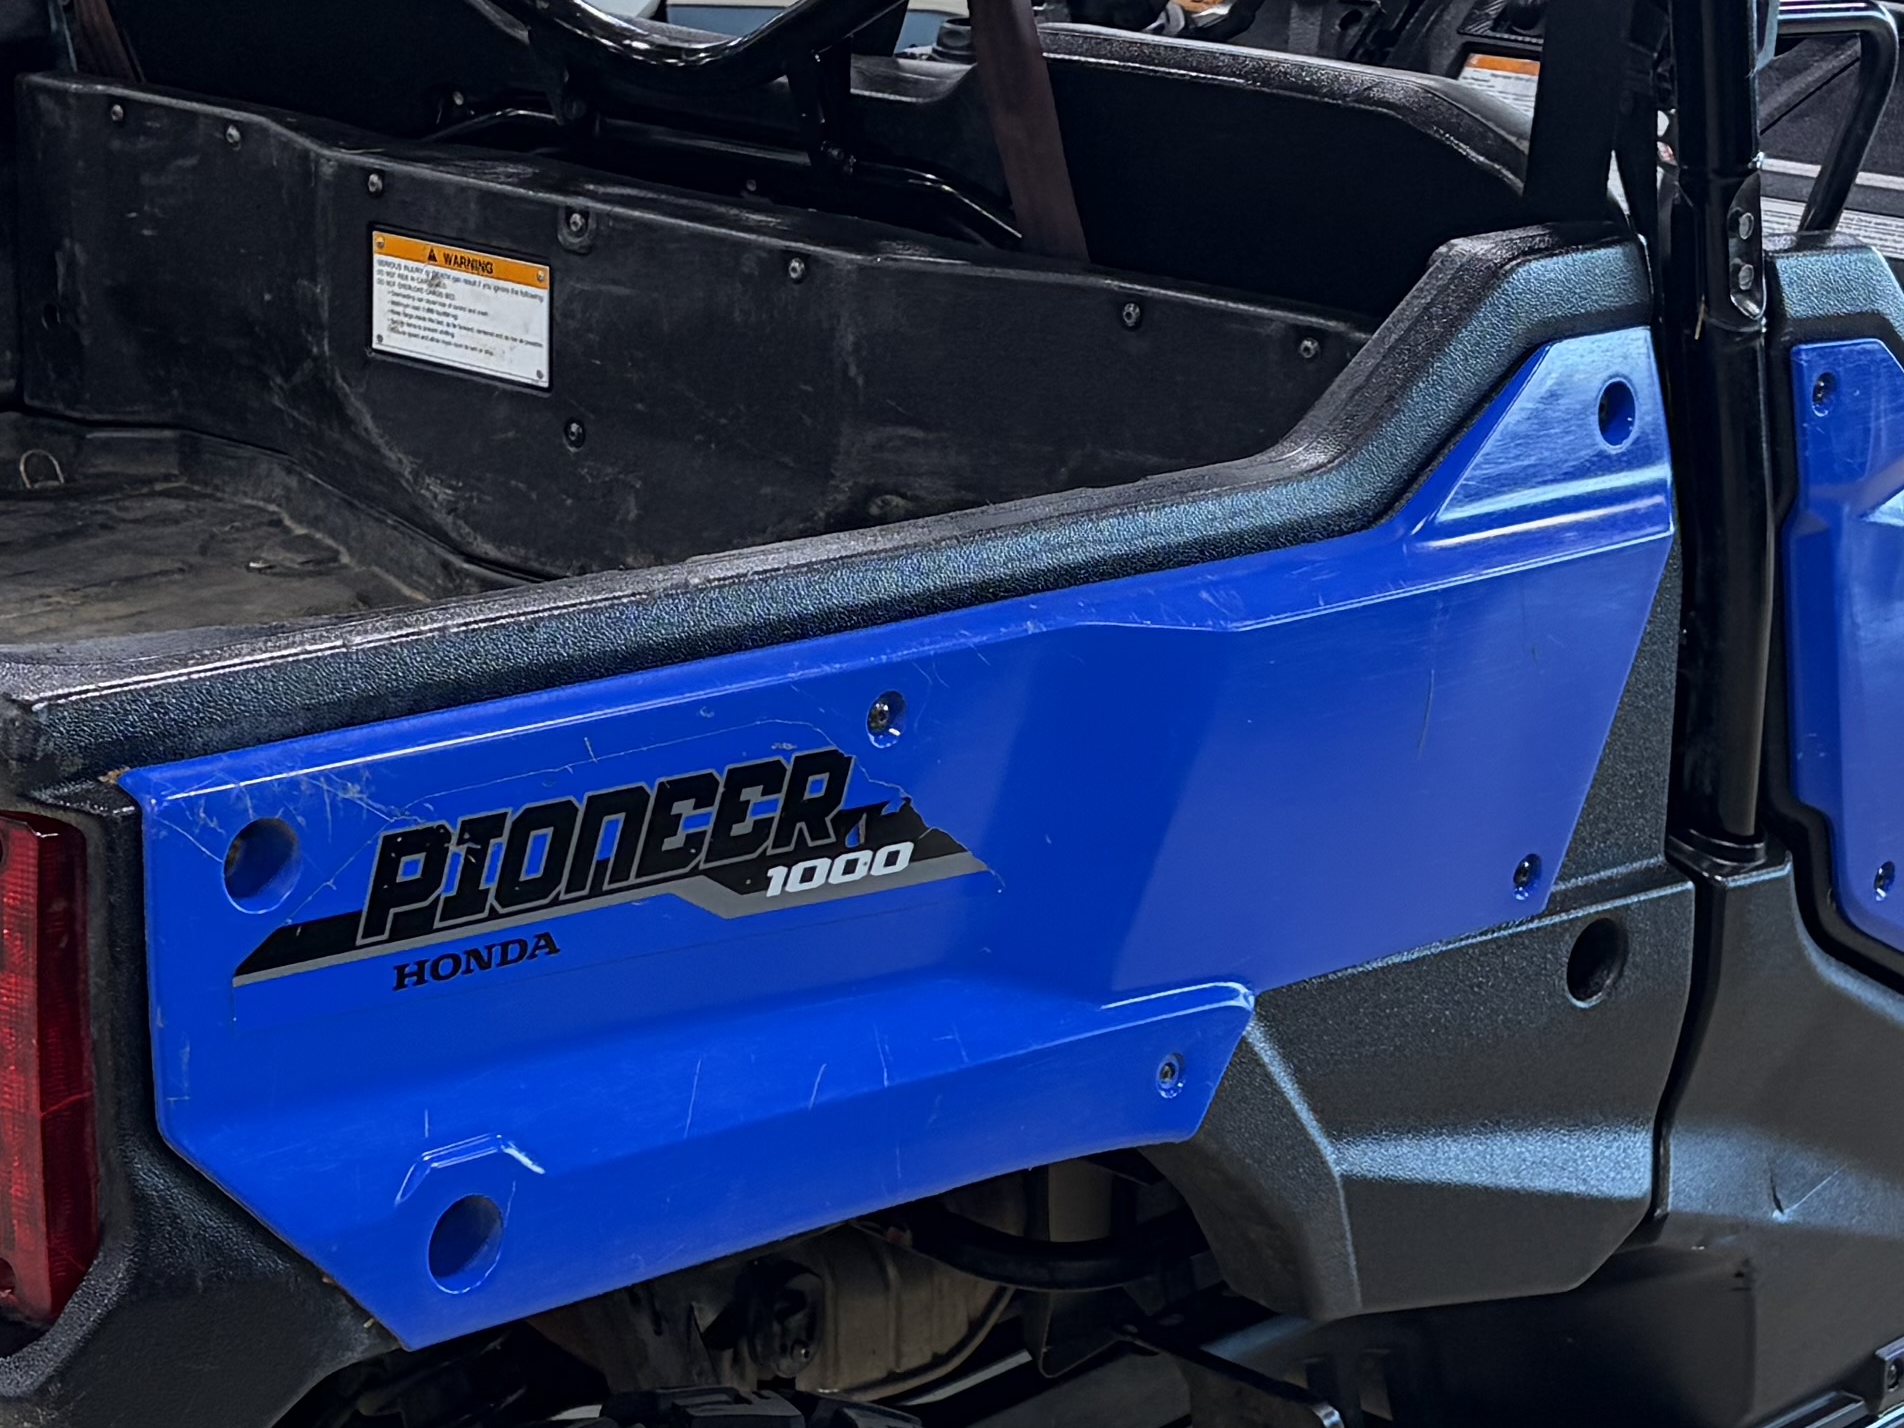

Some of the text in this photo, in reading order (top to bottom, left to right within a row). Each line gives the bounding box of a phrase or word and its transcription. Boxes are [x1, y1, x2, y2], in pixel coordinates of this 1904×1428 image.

[442, 252, 494, 275] WARNING
[356, 747, 915, 946] PIONEER 1000
[392, 930, 561, 992] HONDA
